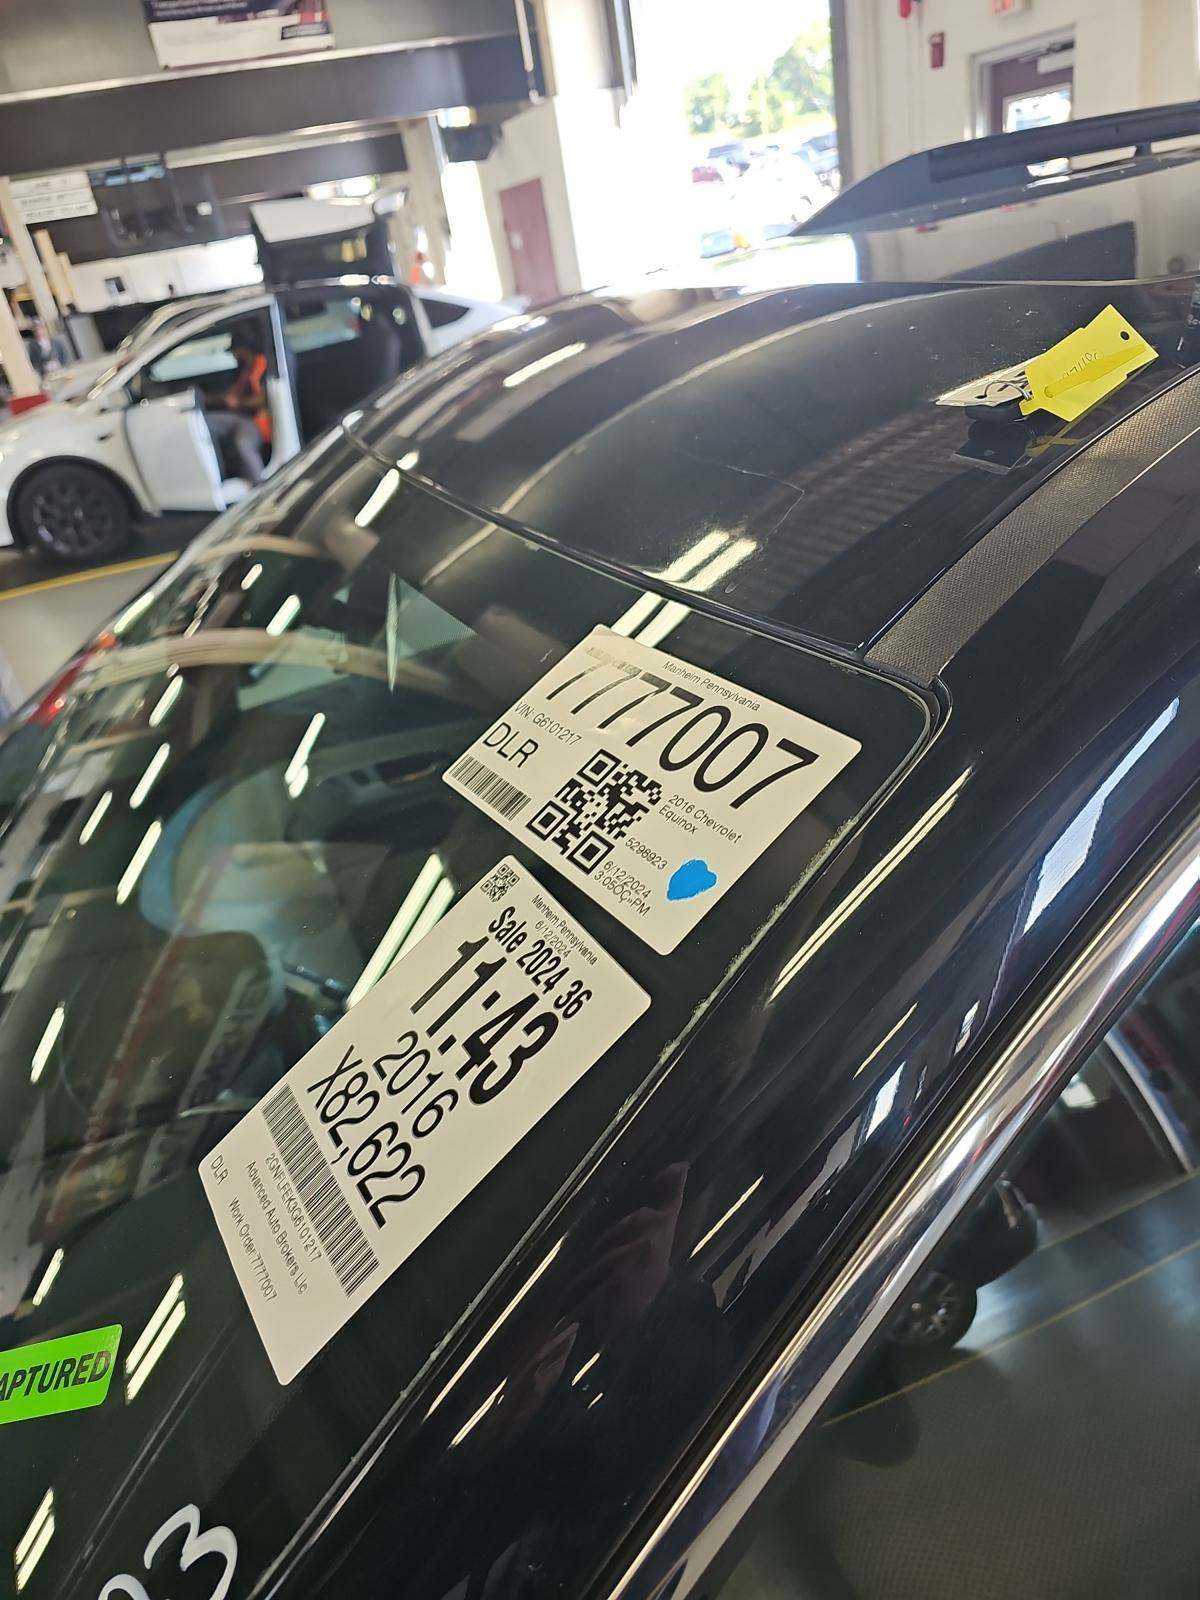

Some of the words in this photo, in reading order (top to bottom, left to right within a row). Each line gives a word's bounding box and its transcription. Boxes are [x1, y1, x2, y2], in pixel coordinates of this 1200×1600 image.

[663, 660, 701, 684] Manheim
[700, 678, 761, 711] Pennsylvania
[482, 721, 539, 768] DLR
[533, 712, 582, 746] G6101217
[546, 648, 820, 810] 7777007
[659, 804, 698, 835] Equinox
[668, 794, 695, 814] 2016
[693, 809, 742, 844] Chevrolet
[625, 837, 668, 870] 5298923
[603, 861, 652, 899] 6/12/2024
[531, 894, 559, 926] Manheim
[556, 919, 598, 965] Pennsylvania
[534, 920, 571, 958] 6/12/2024
[488, 906, 527, 953] Sale
[516, 939, 570, 995] 2024
[553, 980, 592, 1020] 36
[410, 935, 560, 1106] 11:43
[372, 1030, 459, 1138] 2016
[306, 1044, 426, 1230] X82,622
[210, 1154, 229, 1185] DLR
[228, 1195, 245, 1229] Work
[246, 1160, 272, 1211] Advanced
[266, 1207, 281, 1234] Auto
[275, 1230, 300, 1277] Brokers
